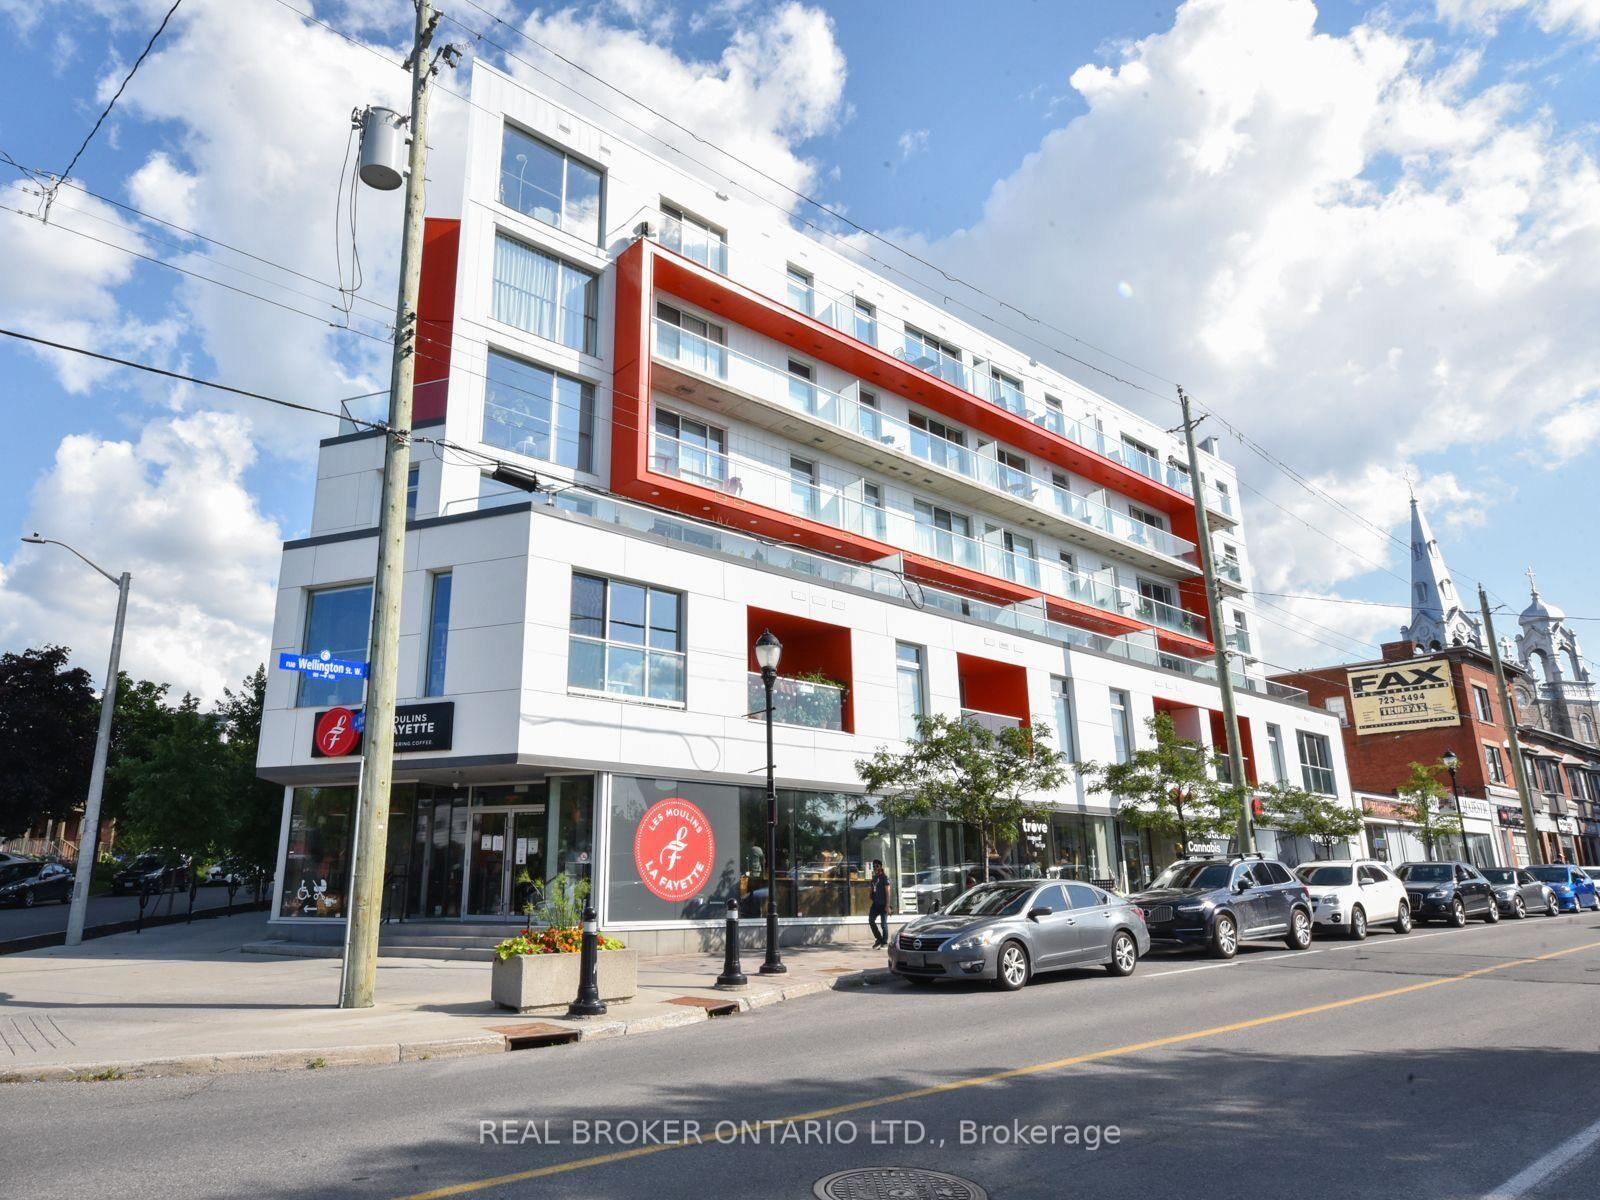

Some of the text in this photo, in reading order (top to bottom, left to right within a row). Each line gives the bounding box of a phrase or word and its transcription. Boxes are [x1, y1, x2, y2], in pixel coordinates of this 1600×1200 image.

[298, 658, 344, 675] Wellington
[354, 667, 362, 676] W.
[1351, 665, 1447, 693] FAX
[1378, 692, 1425, 705] 723-5494
[394, 713, 427, 724] OULINS
[393, 722, 435, 735] AYETTE
[648, 808, 703, 834] LES MOULINS
[1187, 840, 1221, 853] Cannabis
[645, 860, 705, 891] LA FAYETTE
